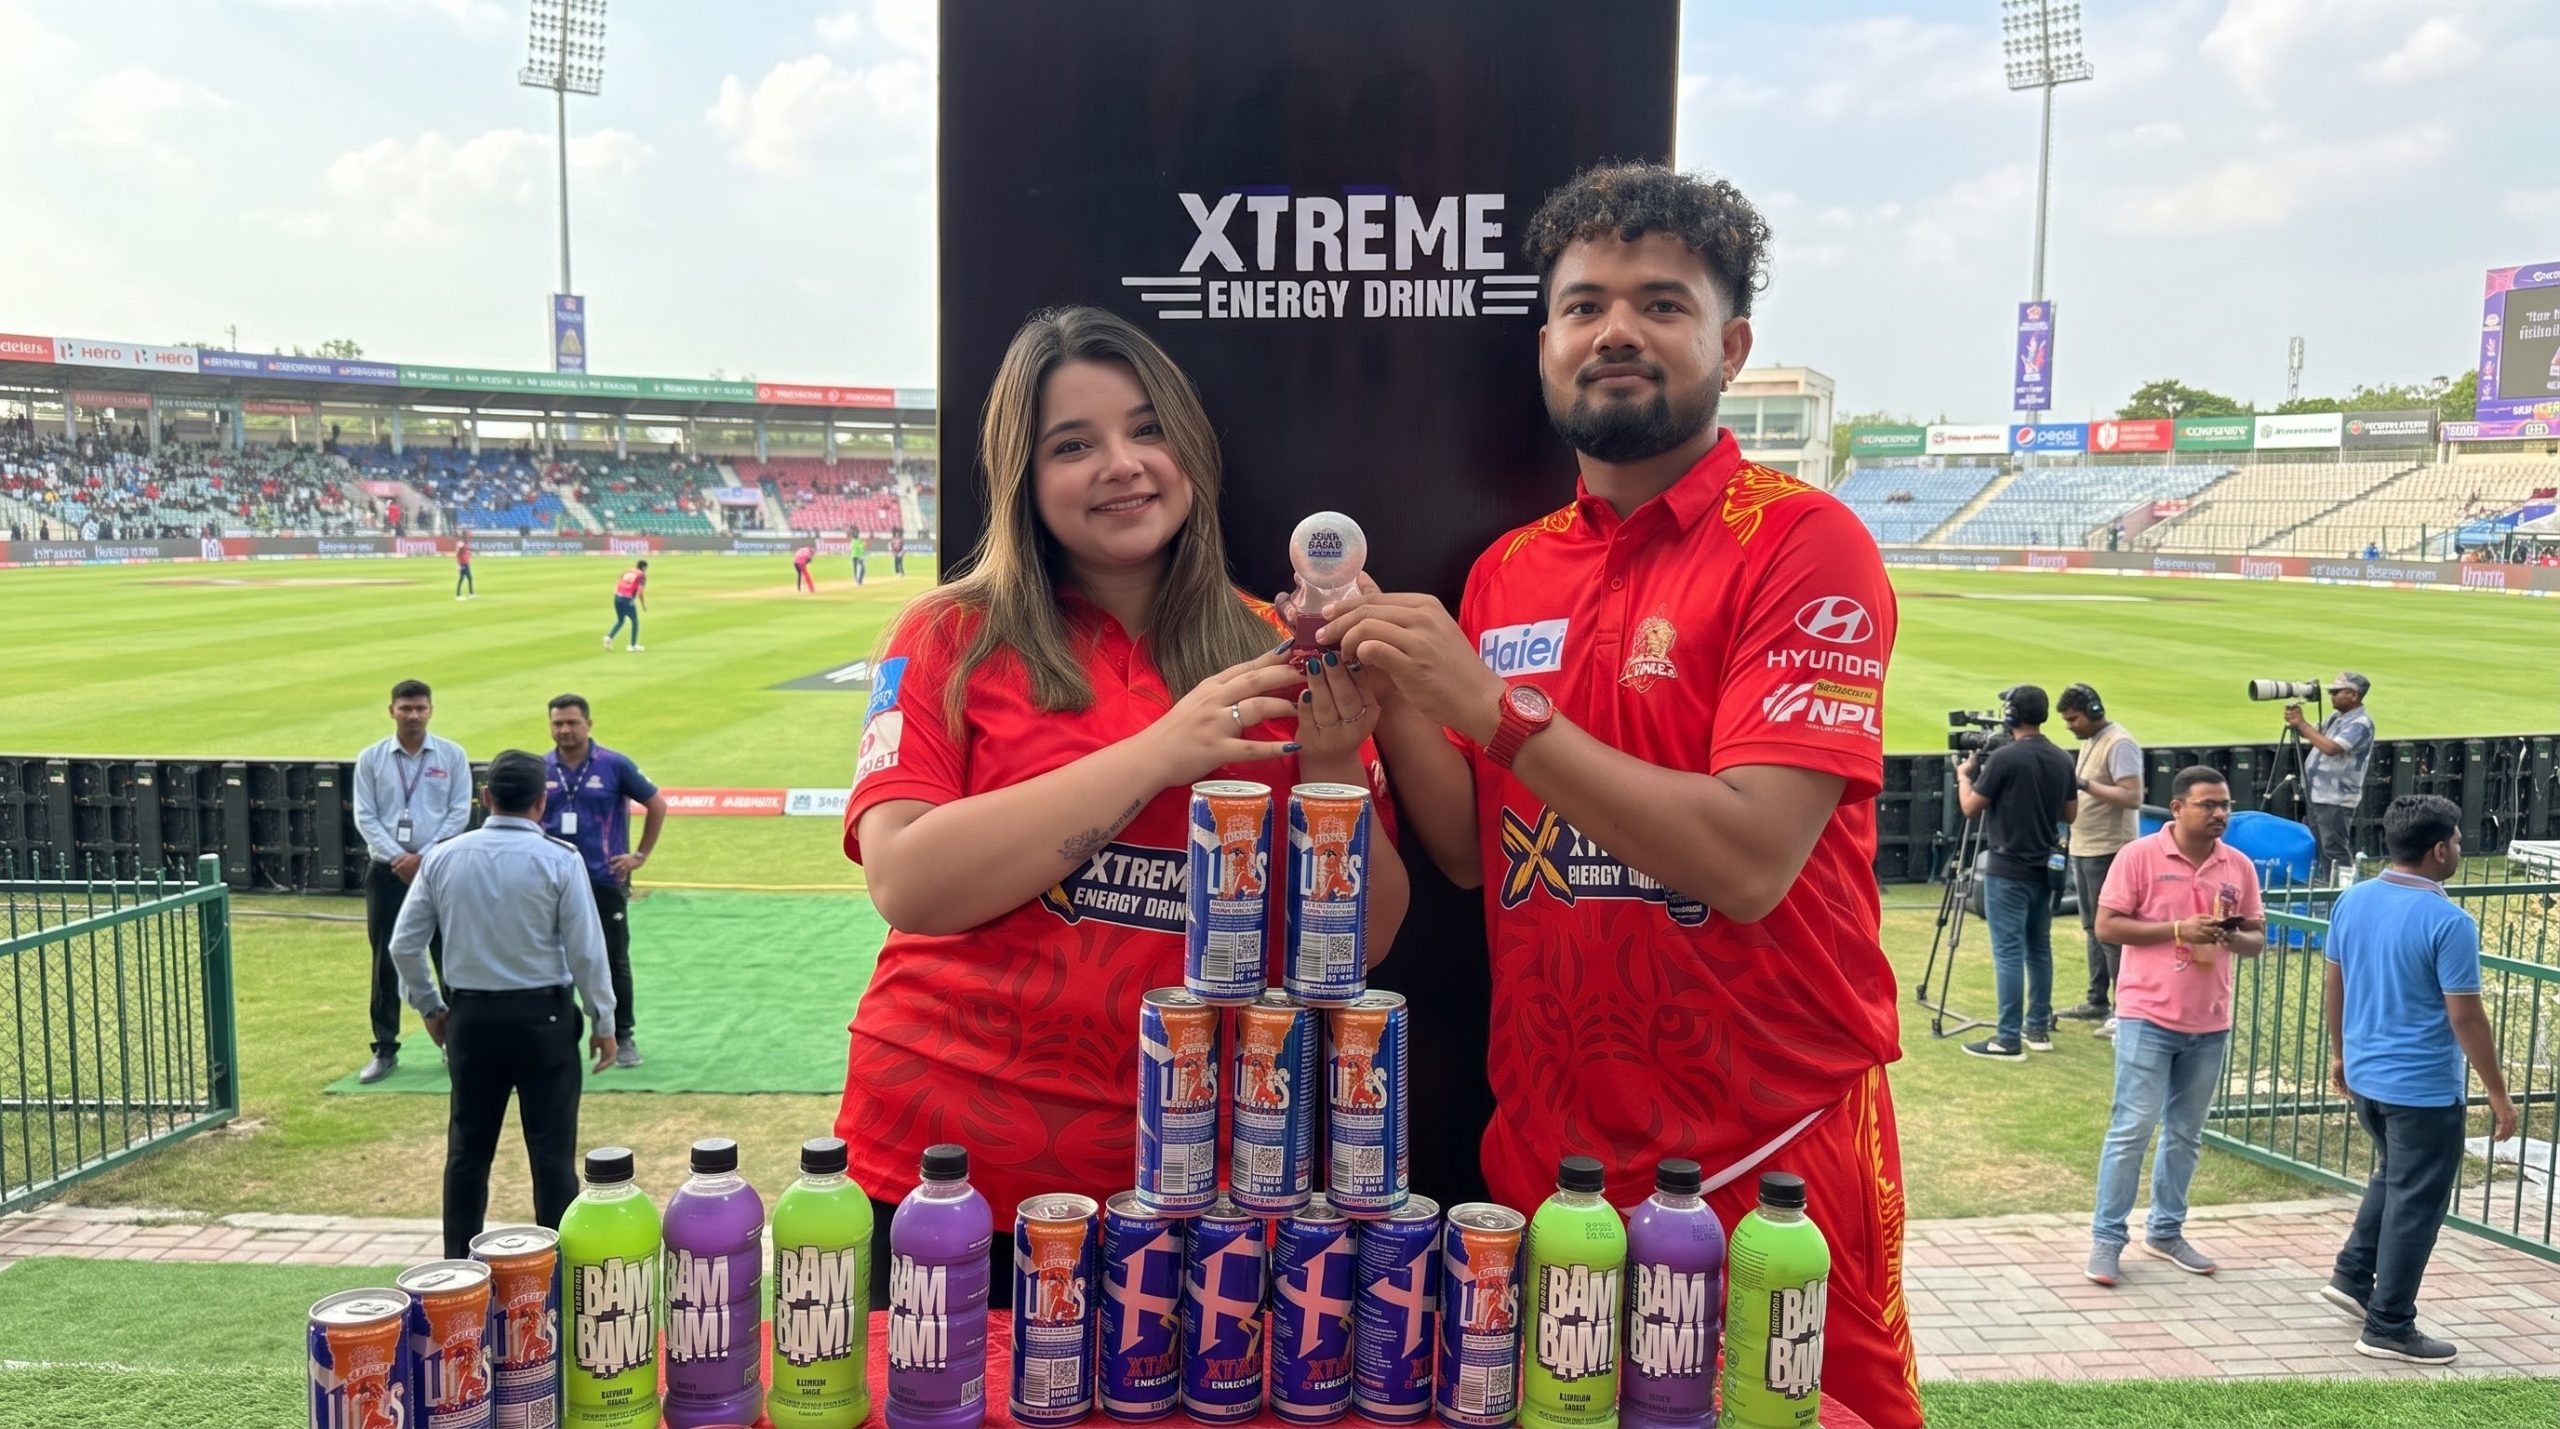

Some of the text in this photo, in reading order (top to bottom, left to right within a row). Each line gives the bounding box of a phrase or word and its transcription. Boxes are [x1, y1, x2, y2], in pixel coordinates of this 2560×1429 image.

[1178, 193, 1505, 273] XTREME
[1208, 279, 1476, 318] ENERGY DRINK
[1482, 627, 1564, 672] Haier
[1807, 698, 1881, 735] NPL
[1074, 887, 1142, 914] ENERGY
[584, 1254, 654, 1317] BAM
[782, 1246, 854, 1308] BAM
[1550, 1264, 1617, 1322] BAM
[1637, 1263, 1705, 1327] BAM
[777, 1300, 854, 1362] BAM!
[1540, 1315, 1615, 1378] BAM!
[1631, 1310, 1704, 1377] BAM!
